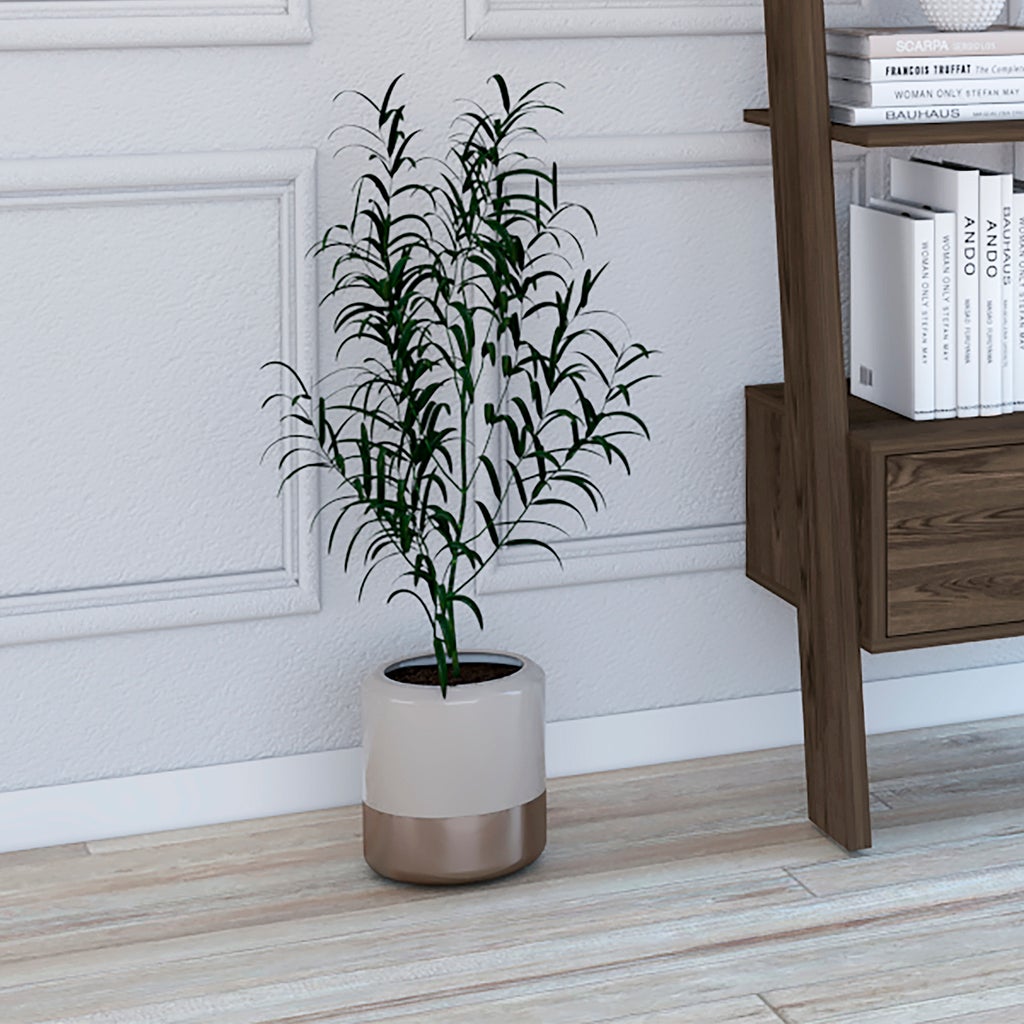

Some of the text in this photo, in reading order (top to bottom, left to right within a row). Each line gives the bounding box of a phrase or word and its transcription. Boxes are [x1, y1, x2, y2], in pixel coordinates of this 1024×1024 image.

[896, 39, 949, 53] SCARPA
[934, 64, 972, 75] TRUFFAT
[894, 88, 1020, 99] WOMAN ONLY STEFAN MAY
[885, 108, 960, 120] BAUHAUS
[921, 242, 929, 280] WOMAN
[942, 234, 951, 274] WOMAN
[964, 216, 976, 276] ANDO
[986, 219, 998, 278] ANDO
[1003, 206, 1012, 285] BAUHAUS
[921, 282, 929, 307] ONLY
[942, 276, 951, 303] ONLY
[921, 310, 929, 344] STEFAN
[942, 306, 950, 340] STEFAN
